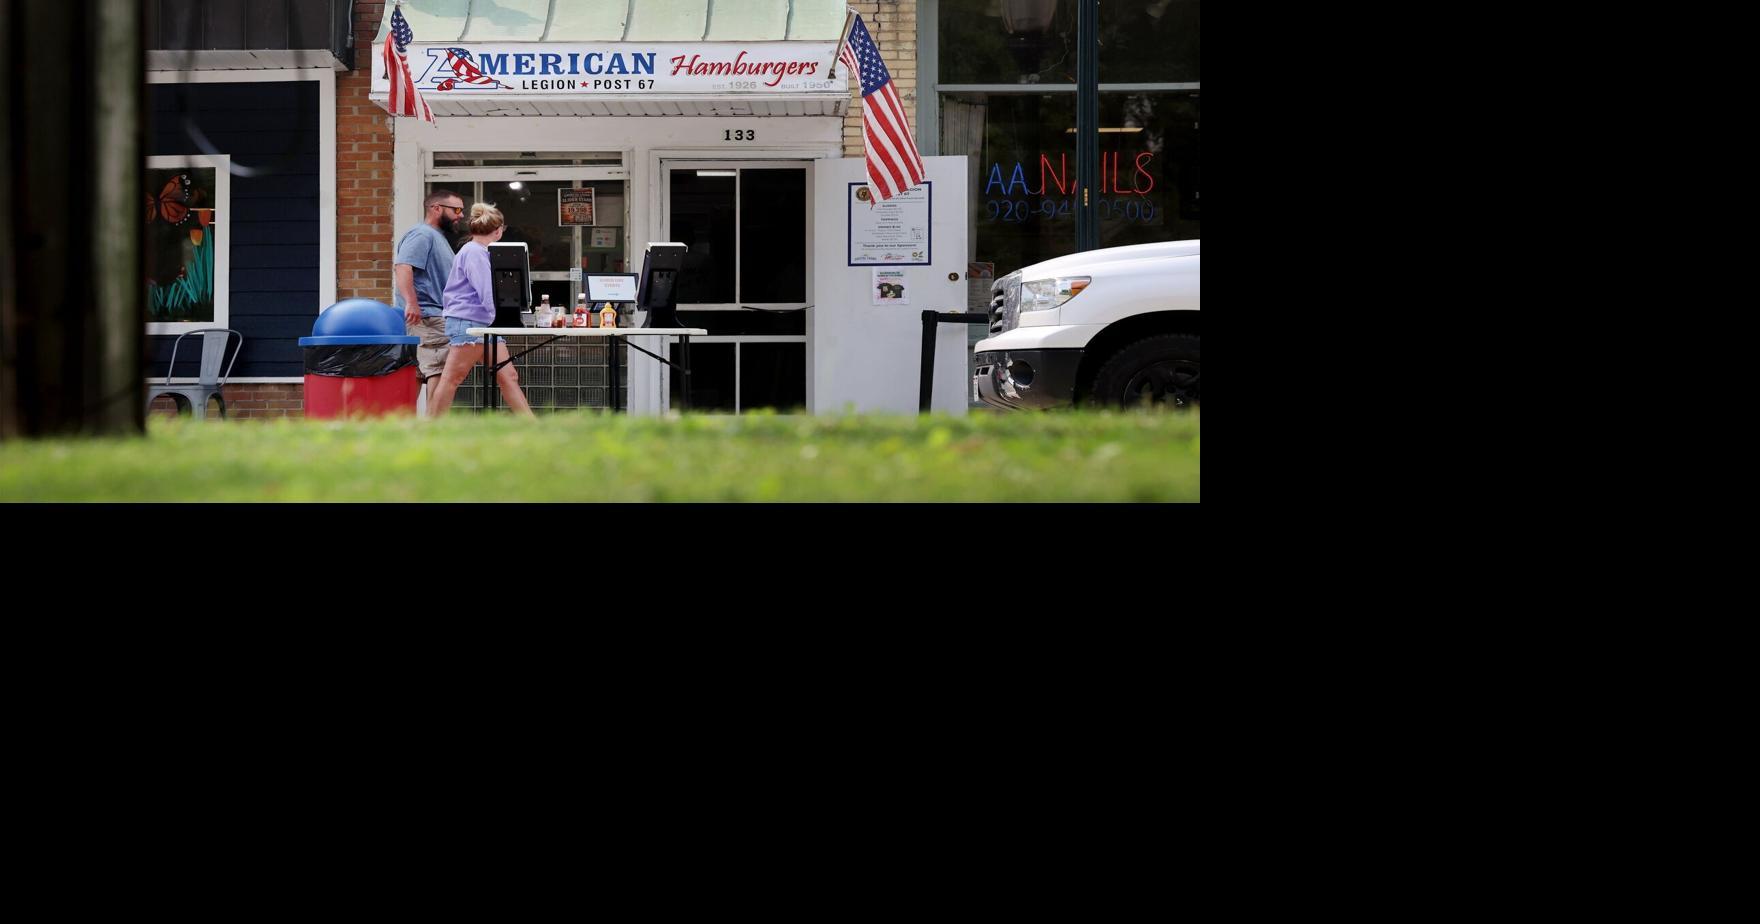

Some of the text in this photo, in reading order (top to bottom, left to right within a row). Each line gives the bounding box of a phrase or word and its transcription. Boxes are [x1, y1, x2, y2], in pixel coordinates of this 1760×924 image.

[415, 48, 819, 91] AMERICAN Hamburgers
[522, 79, 655, 90] LEGION POST 67
[724, 129, 755, 141] 133
[985, 152, 1154, 195] AA NILS
[986, 199, 1154, 222] 920-940500
